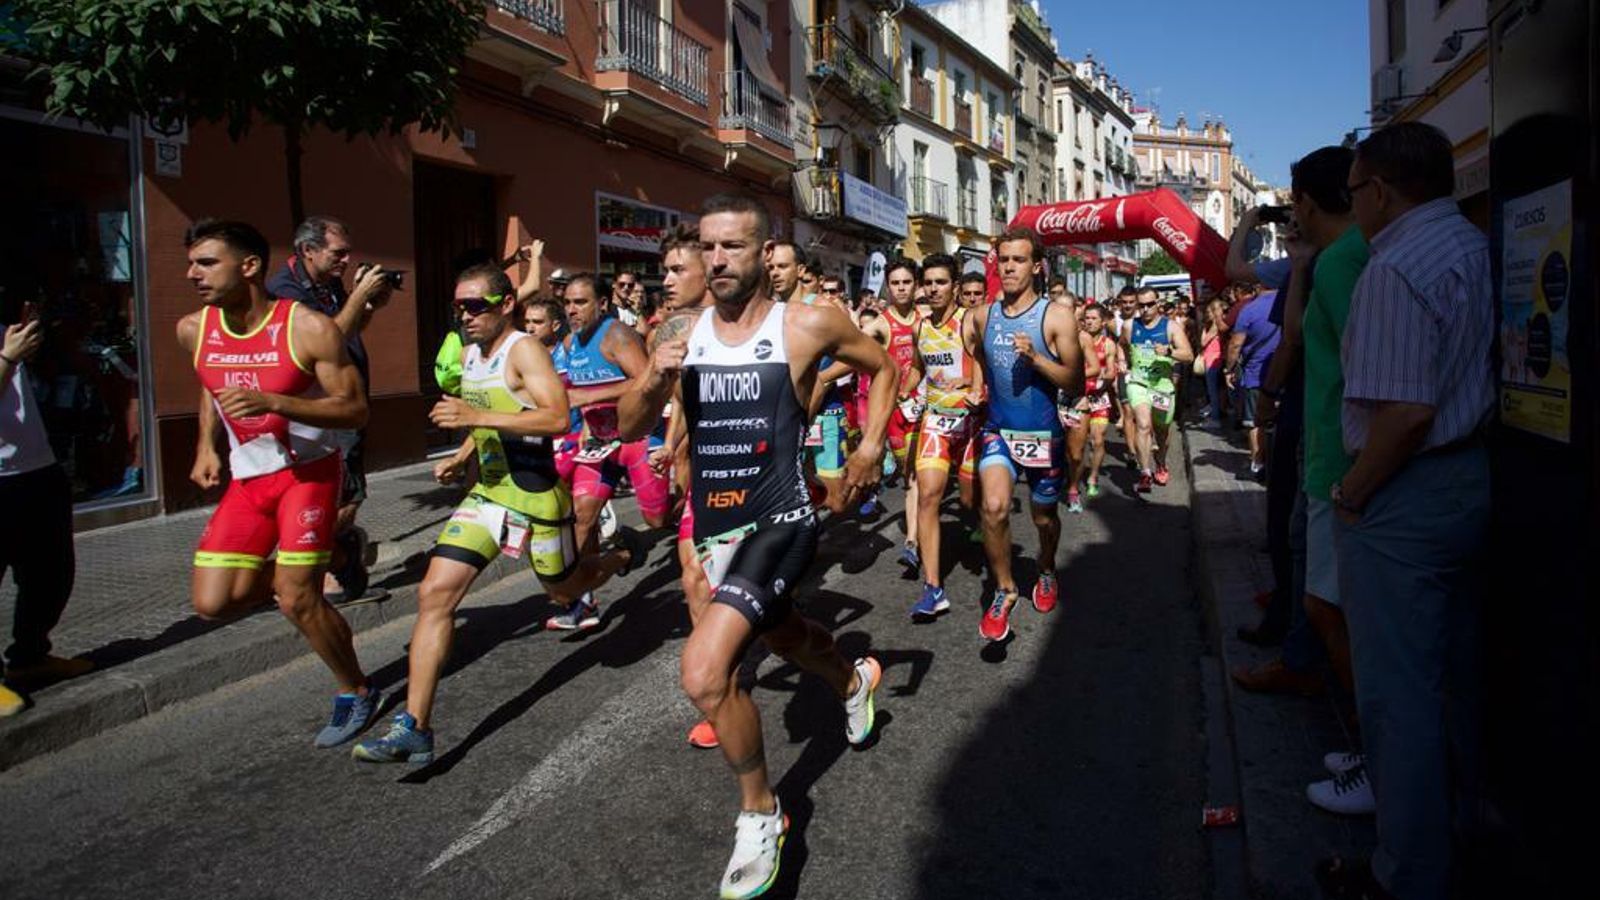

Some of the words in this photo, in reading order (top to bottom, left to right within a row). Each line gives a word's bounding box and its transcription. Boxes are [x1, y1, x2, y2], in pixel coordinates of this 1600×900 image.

[223, 371, 262, 392] MESA
[699, 371, 760, 403] MONTORO
[936, 416, 957, 430] 47
[697, 443, 753, 456] LASERGRAN
[1014, 442, 1038, 459] 52
[706, 488, 750, 508] HSN
